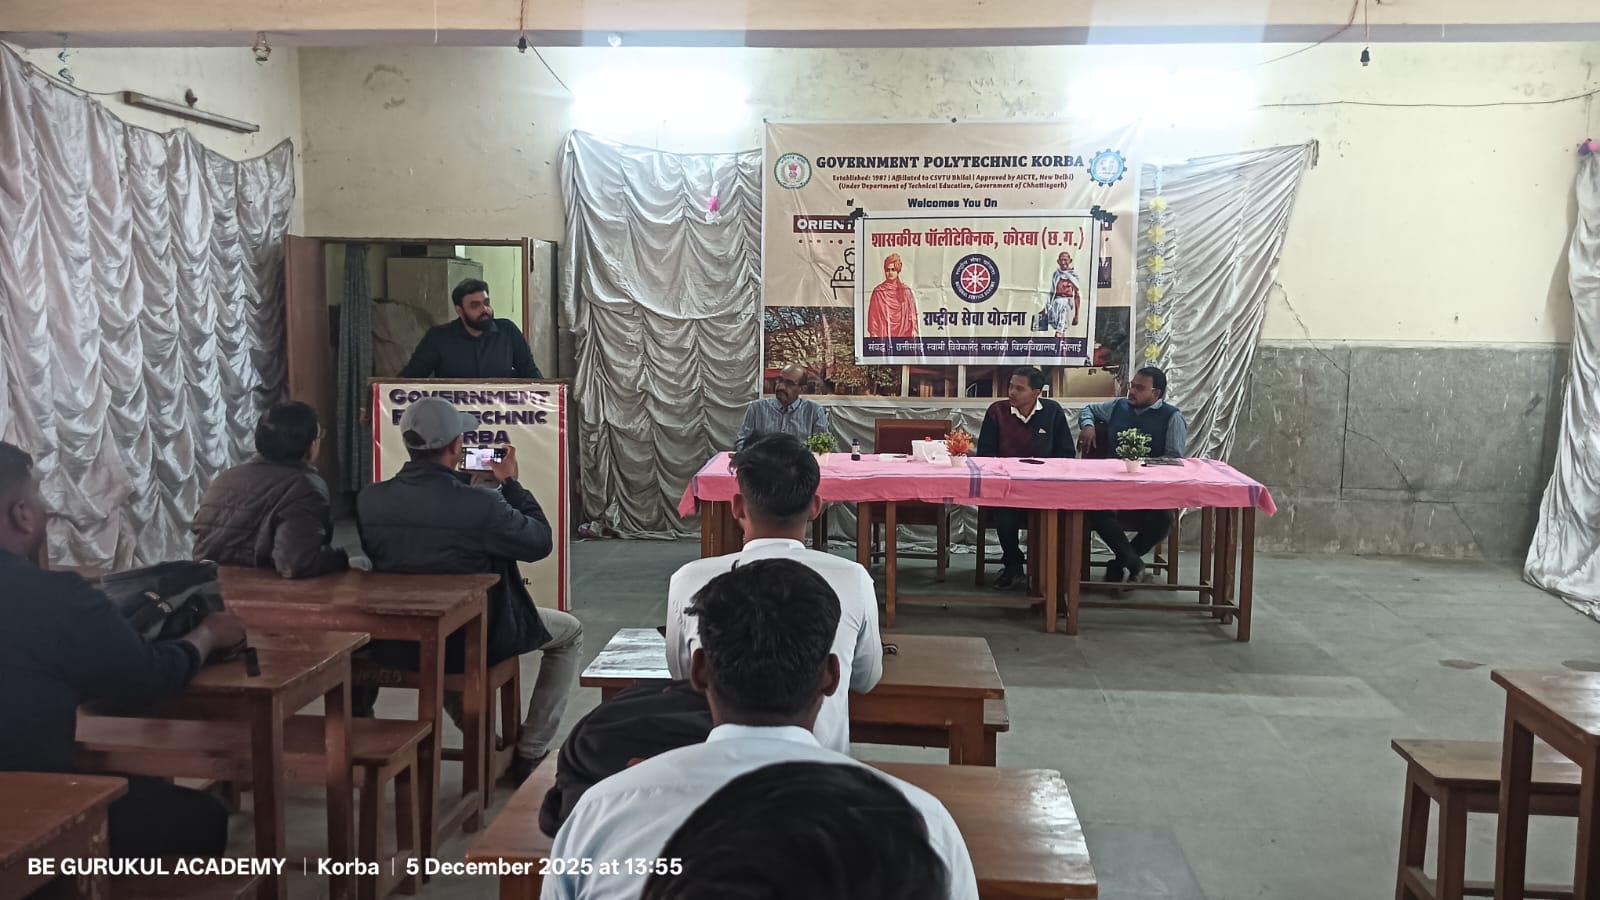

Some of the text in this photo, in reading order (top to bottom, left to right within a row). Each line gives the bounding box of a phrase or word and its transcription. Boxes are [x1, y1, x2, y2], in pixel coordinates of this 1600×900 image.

[816, 156, 919, 168] GOVERNMENT
[923, 155, 1027, 168] POLYTECHNIC
[1031, 155, 1084, 167] KORBA
[891, 174, 921, 182] Affiliated
[976, 174, 1007, 182] Approved
[1008, 174, 1016, 182] by
[1054, 173, 1074, 181] Delhi)
[838, 183, 860, 191] (Under
[862, 182, 899, 191] Department
[900, 182, 908, 190] of
[909, 182, 938, 190] Technical
[939, 182, 973, 190] Education,
[975, 182, 1013, 190] Government
[1014, 182, 1022, 190] of
[908, 198, 998, 208] Welcomes You On
[872, 226, 1084, 250] शासकीय पॉलीटेक्निक, कोरबा (छ.ग.)
[923, 307, 1027, 330] राष्ट्रीय सेवा योजना
[927, 341, 945, 351] स्वामी
[948, 340, 978, 352] विवेकानंद
[981, 340, 1009, 352] तकनीकी
[1060, 340, 1082, 352] भिलाई
